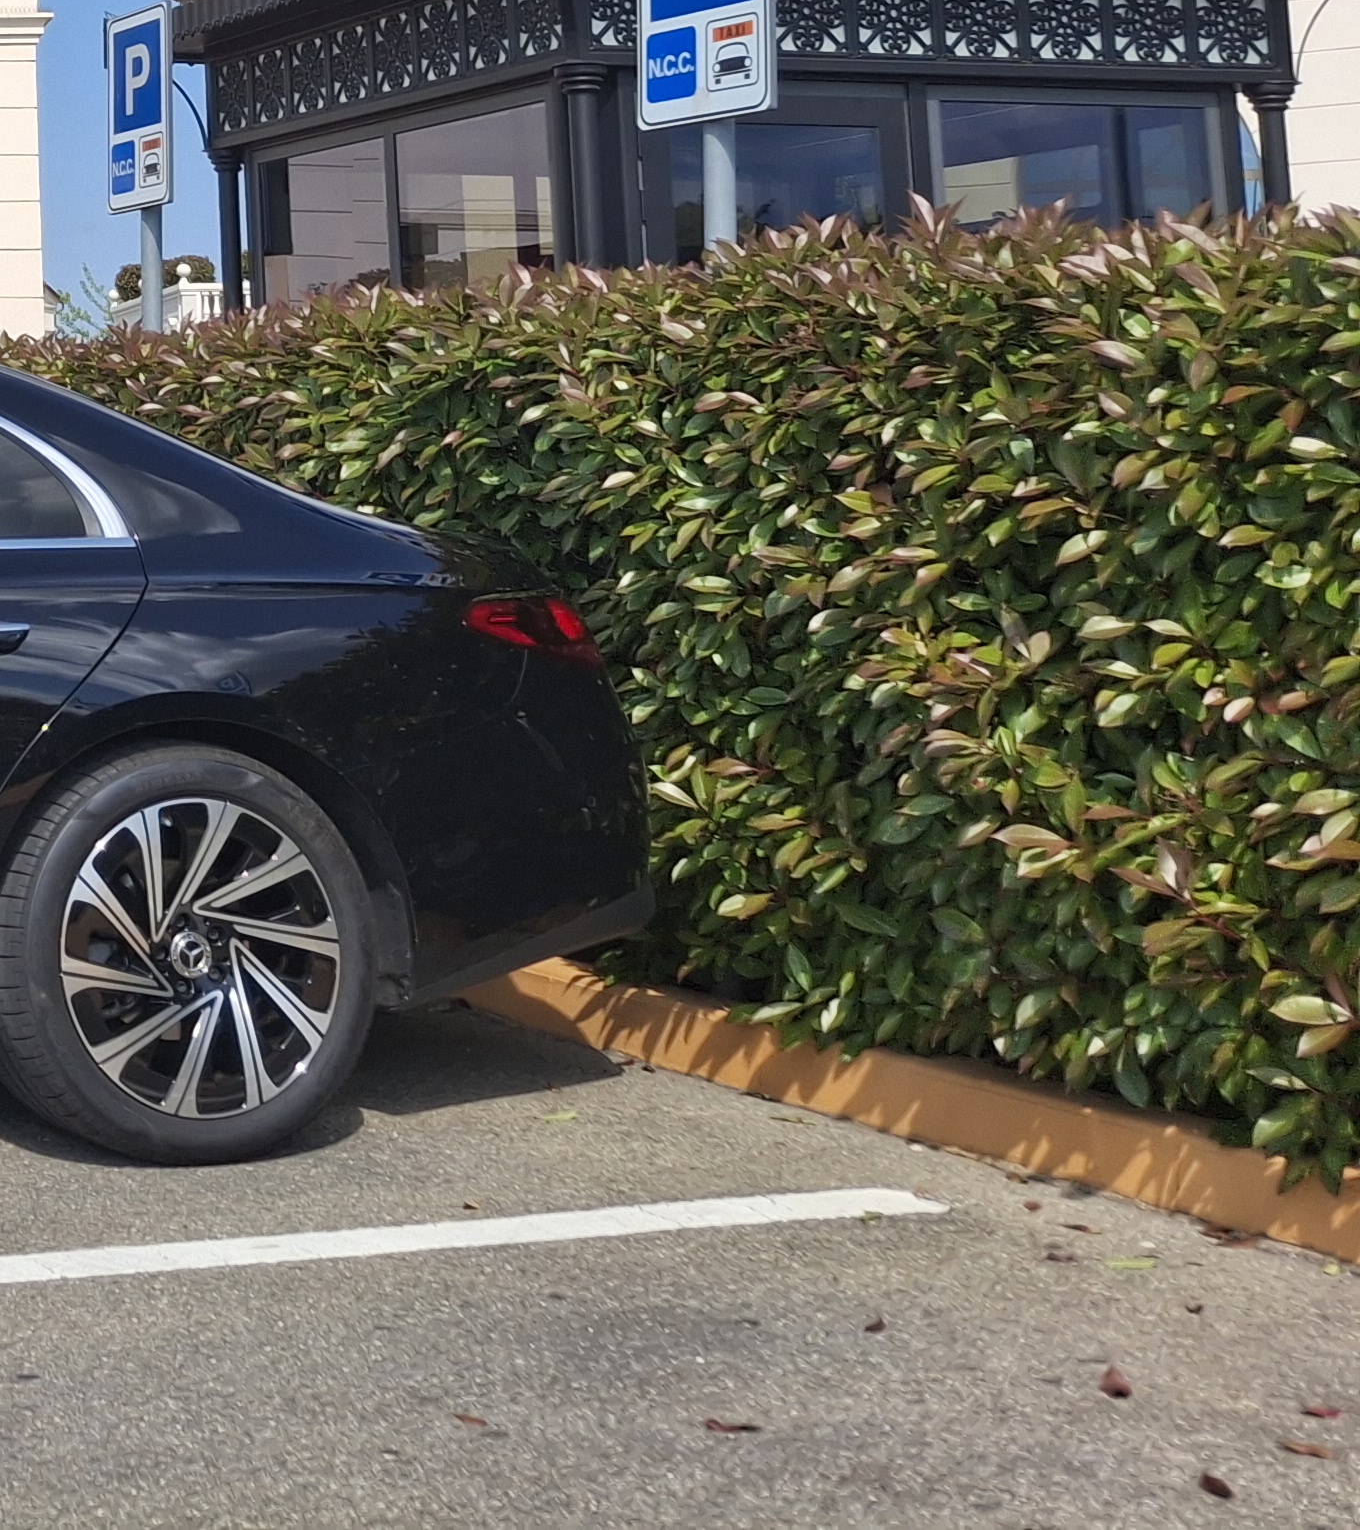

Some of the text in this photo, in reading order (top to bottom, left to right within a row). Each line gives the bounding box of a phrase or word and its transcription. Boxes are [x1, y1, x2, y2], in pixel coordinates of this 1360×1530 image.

[719, 24, 747, 40] TAXI
[648, 51, 695, 79] N.C.C.
[125, 43, 151, 116] P
[112, 157, 135, 178] N.C.C.
